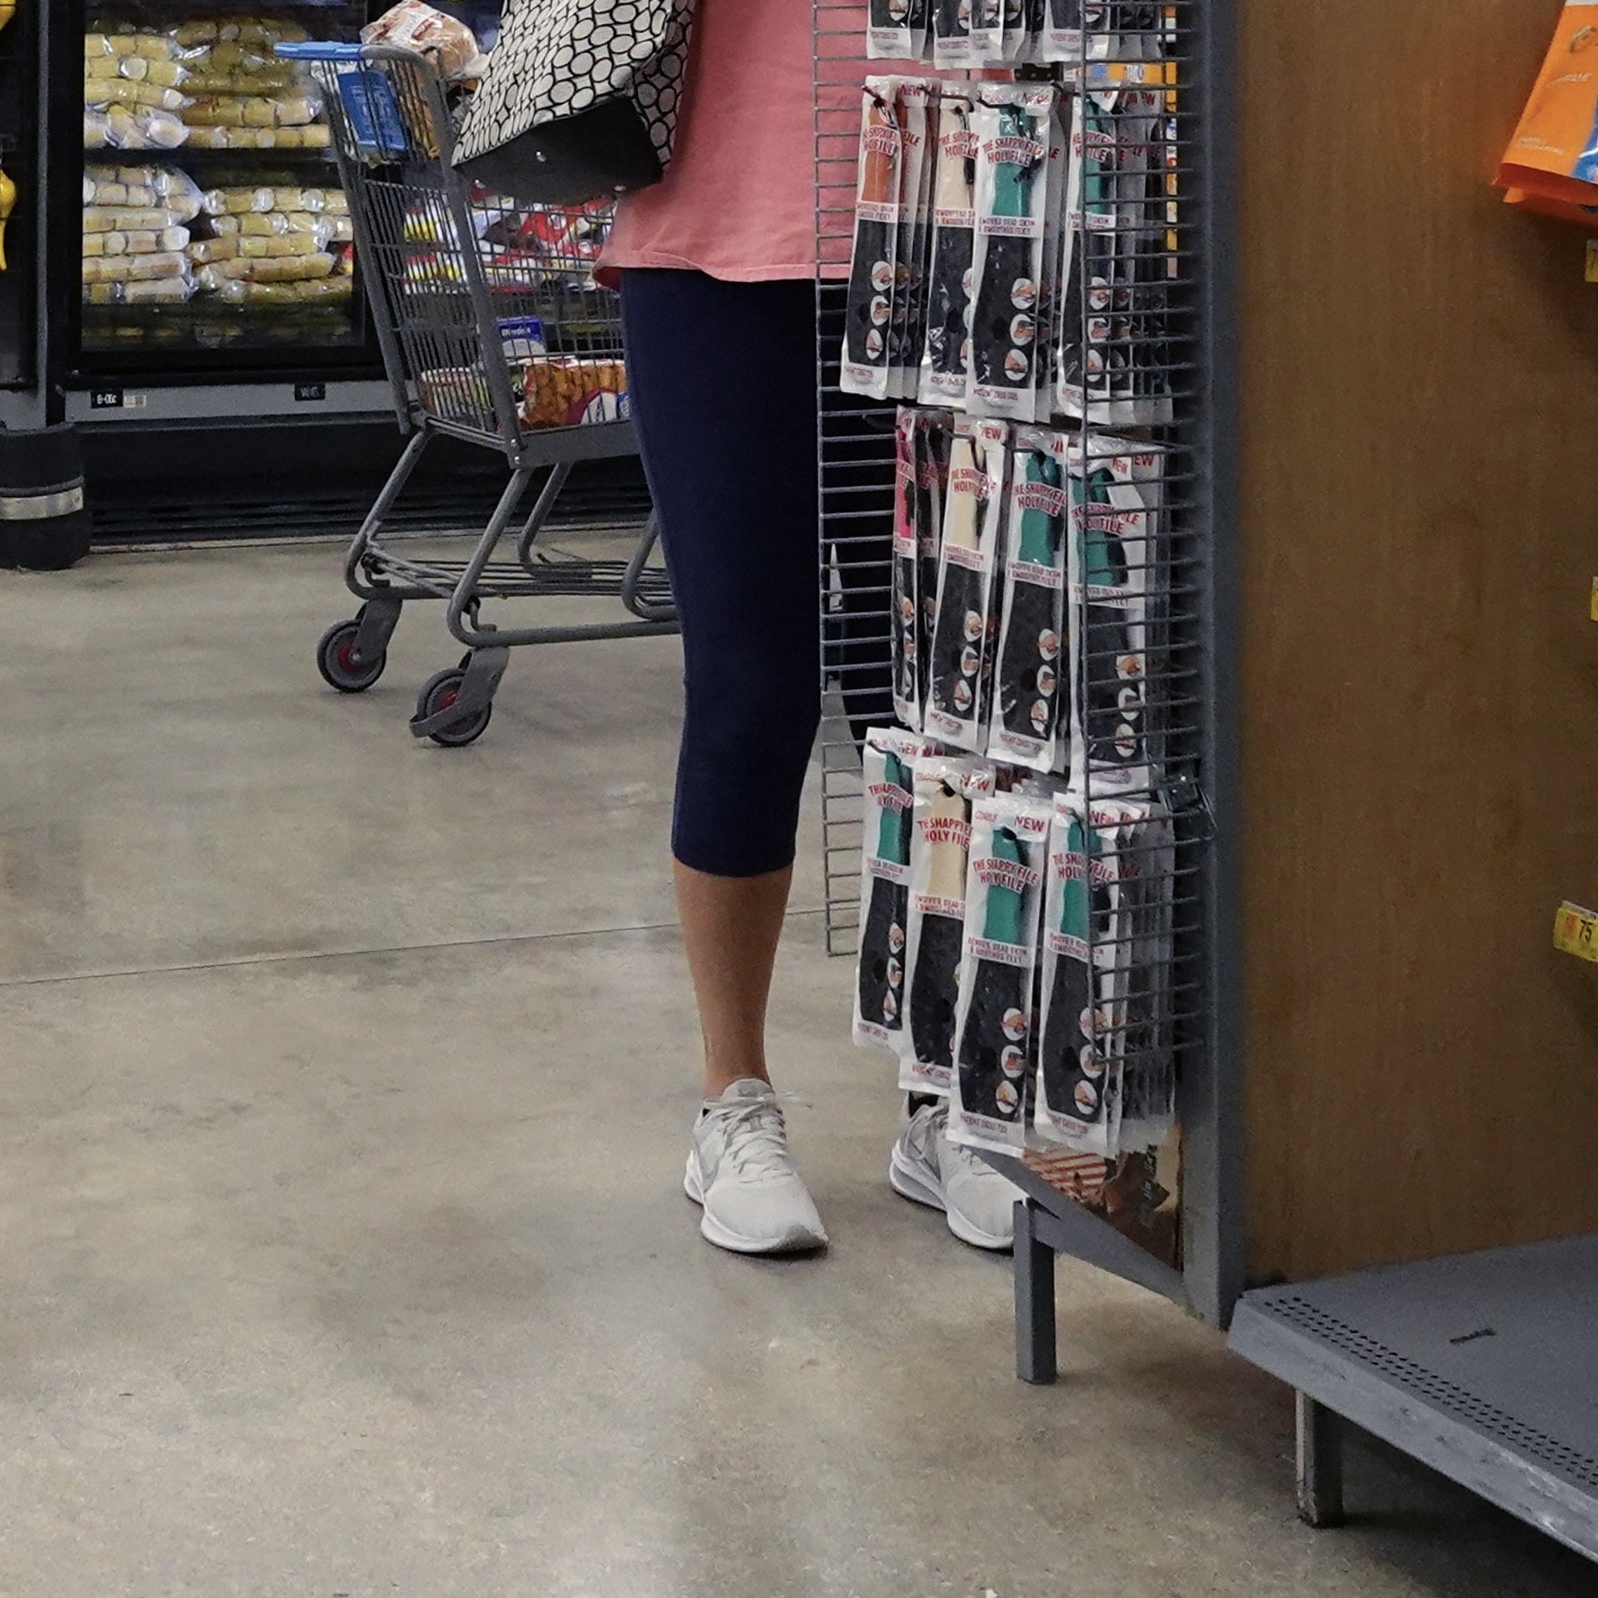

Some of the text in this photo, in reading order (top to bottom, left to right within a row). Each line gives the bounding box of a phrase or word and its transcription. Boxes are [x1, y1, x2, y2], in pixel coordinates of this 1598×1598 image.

[1014, 816, 1045, 832] NEW
[1018, 866, 1039, 883] FILE
[1002, 875, 1024, 891] FILE
